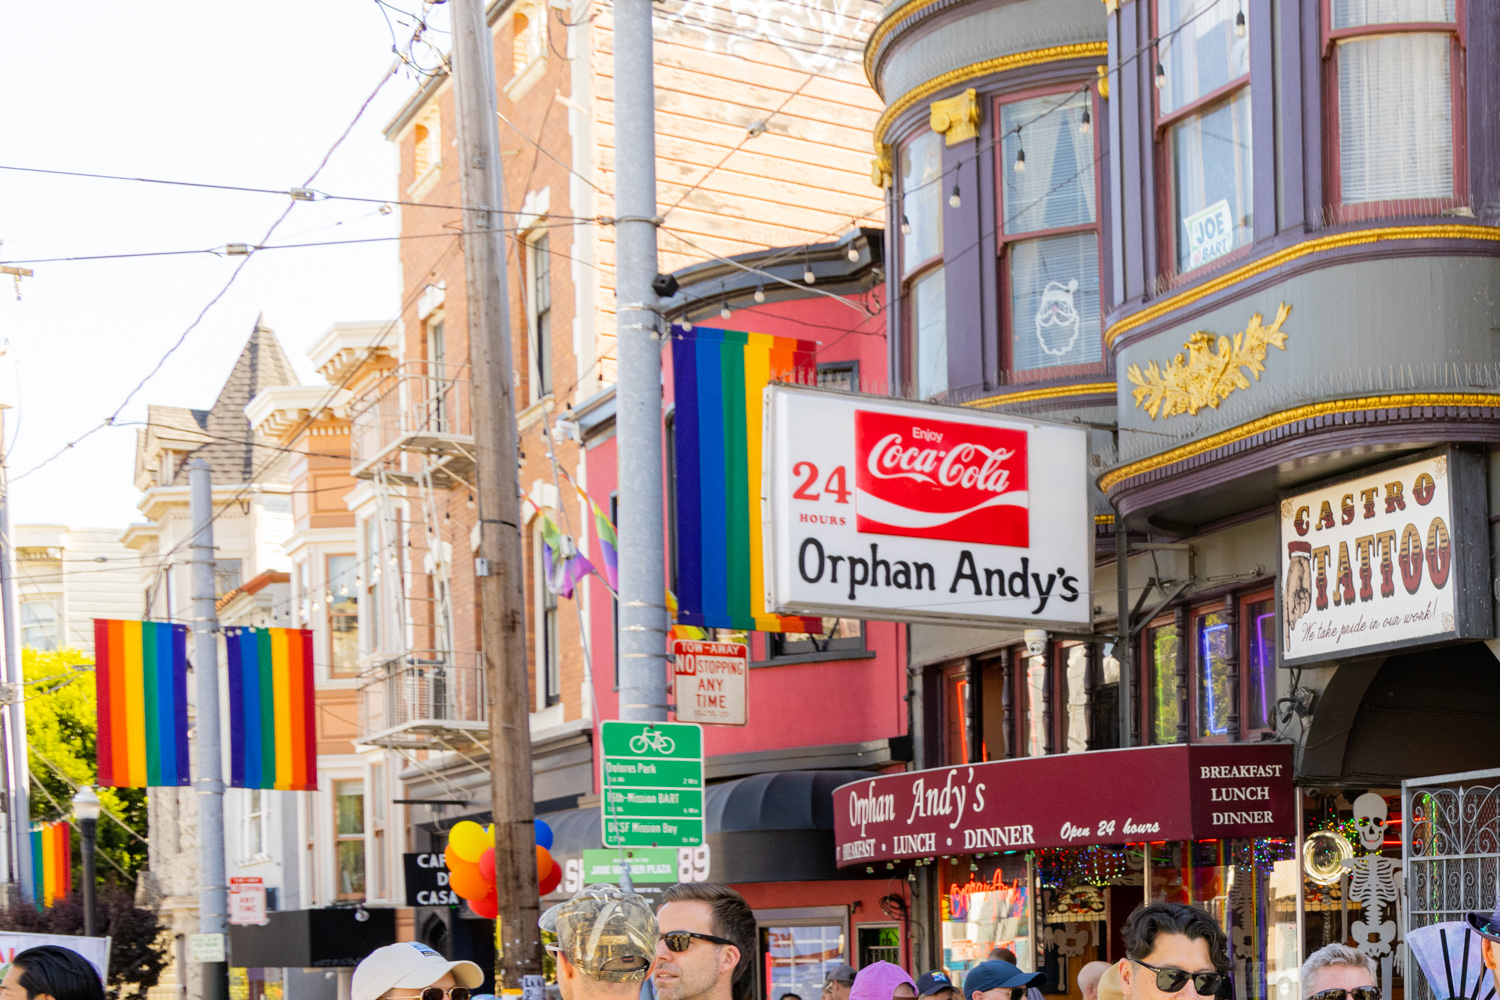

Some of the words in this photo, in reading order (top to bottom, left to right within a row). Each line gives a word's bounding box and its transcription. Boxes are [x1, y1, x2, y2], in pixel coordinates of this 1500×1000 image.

[1197, 212, 1225, 244] JOE
[912, 427, 943, 442] Enjoy
[867, 433, 1015, 492] Coca-Cola
[792, 462, 851, 504] 24
[1294, 472, 1436, 536] CASTRO
[800, 514, 846, 526] HOURS
[1313, 517, 1450, 611] TATTOO
[799, 537, 935, 600] Orphan
[949, 550, 1079, 614] Andy's
[1302, 622, 1315, 642] We
[1317, 620, 1338, 639] take
[1337, 614, 1367, 643] pride
[1369, 618, 1380, 630] in
[1382, 616, 1402, 627] our
[1403, 597, 1438, 624] work!
[681, 642, 740, 655] TOW-AWAY
[676, 654, 695, 673] NO
[698, 660, 743, 675] STOPPING
[698, 678, 724, 691] ANY
[696, 694, 726, 708] TIME
[605, 762, 637, 773] Dolores
[637, 763, 656, 774] Park
[1200, 764, 1283, 780] BREAKFAST
[658, 793, 680, 804] BART
[1211, 787, 1270, 801] LUNCH
[849, 779, 896, 837] Orphan
[907, 768, 986, 830] Andy's
[1212, 811, 1274, 826] DINNER
[632, 822, 661, 833] Mission
[662, 823, 678, 835] Bay
[893, 833, 936, 854] LUNCH
[964, 825, 1036, 849] DINNER
[1060, 822, 1091, 841] Open
[1097, 820, 1116, 837] 24
[1123, 818, 1160, 836] hours
[590, 865, 611, 875] JANE
[647, 864, 672, 875] PLAZA
[437, 872, 452, 886] D
[417, 890, 459, 905] CASA
